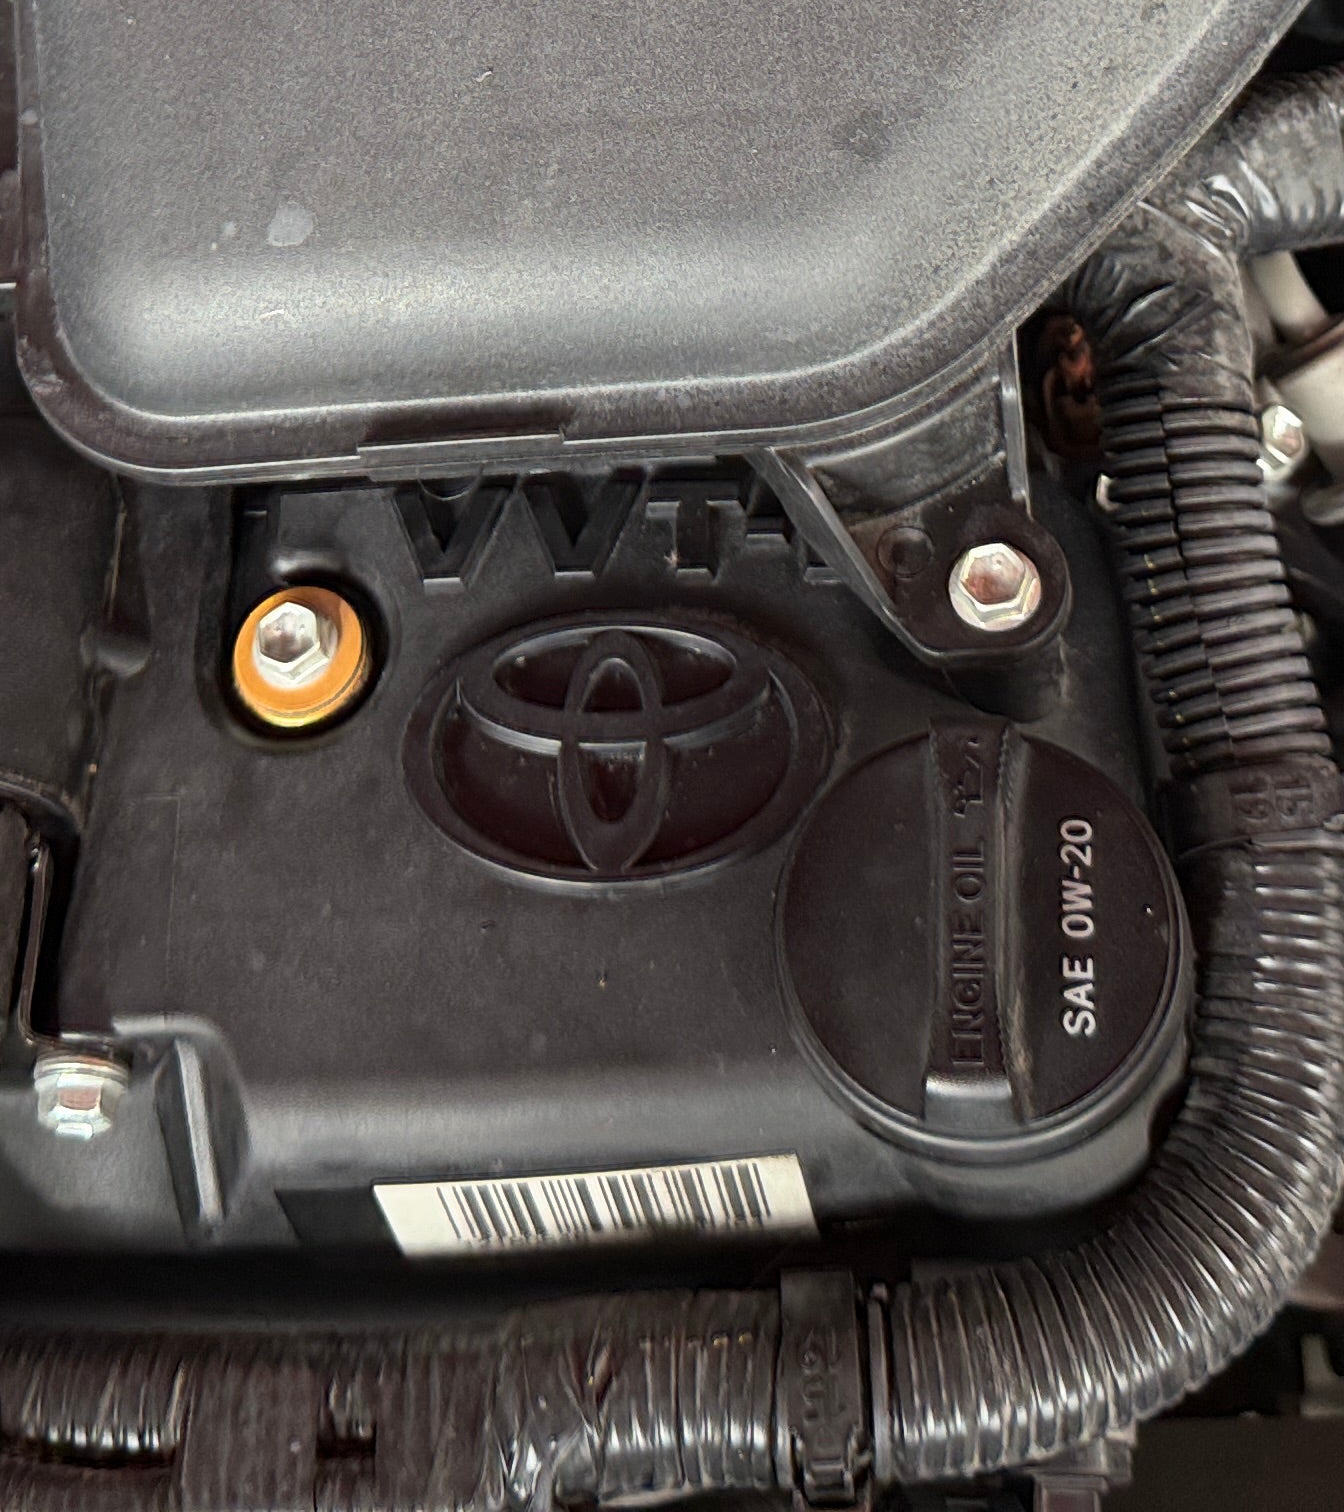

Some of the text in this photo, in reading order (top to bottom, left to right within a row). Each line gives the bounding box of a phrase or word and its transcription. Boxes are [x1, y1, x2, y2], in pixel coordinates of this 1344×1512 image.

[951, 839, 985, 1066] ENGINE OIL
[1060, 817, 1098, 1039] SAE 0W-20
